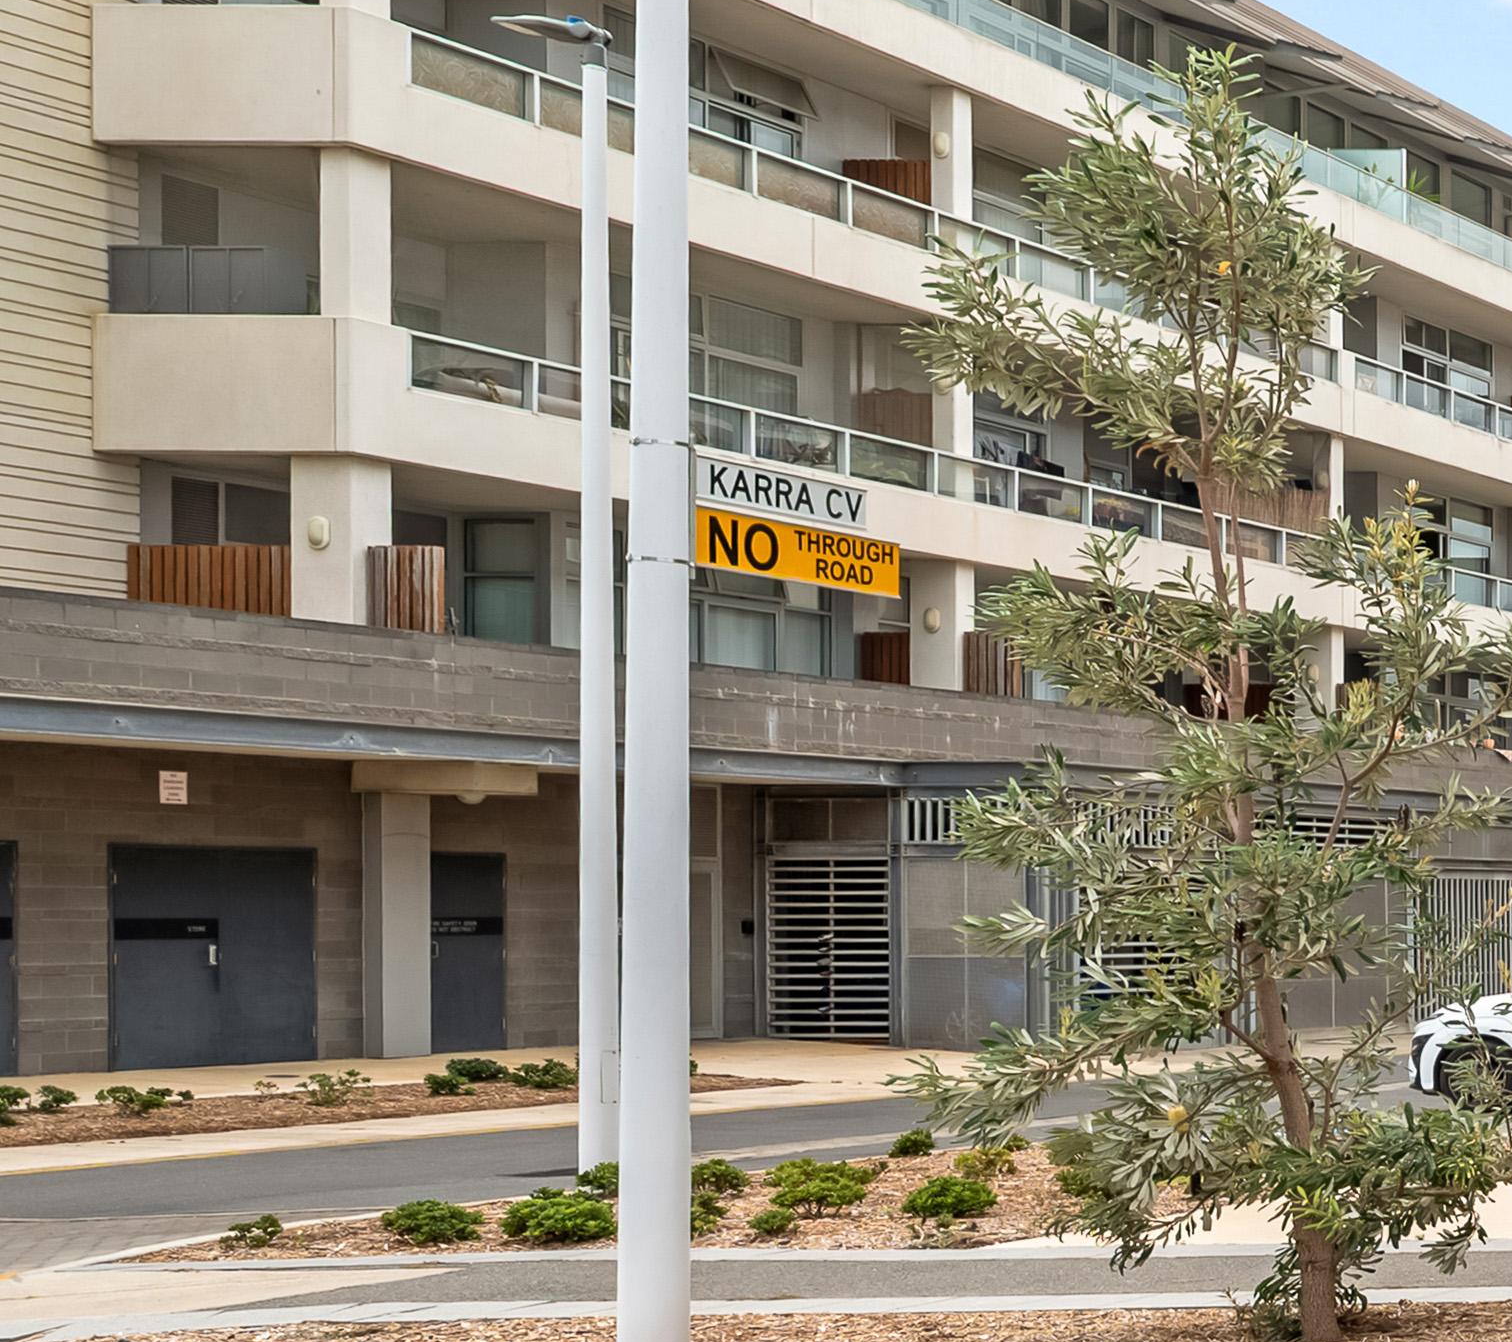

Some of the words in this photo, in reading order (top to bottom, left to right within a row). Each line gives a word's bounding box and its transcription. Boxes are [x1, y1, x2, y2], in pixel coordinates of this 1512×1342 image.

[710, 464, 815, 514] KARRA
[826, 488, 863, 522] CV
[708, 516, 779, 571] NO
[794, 530, 895, 565] THROUGH
[815, 558, 874, 586] ROAD
